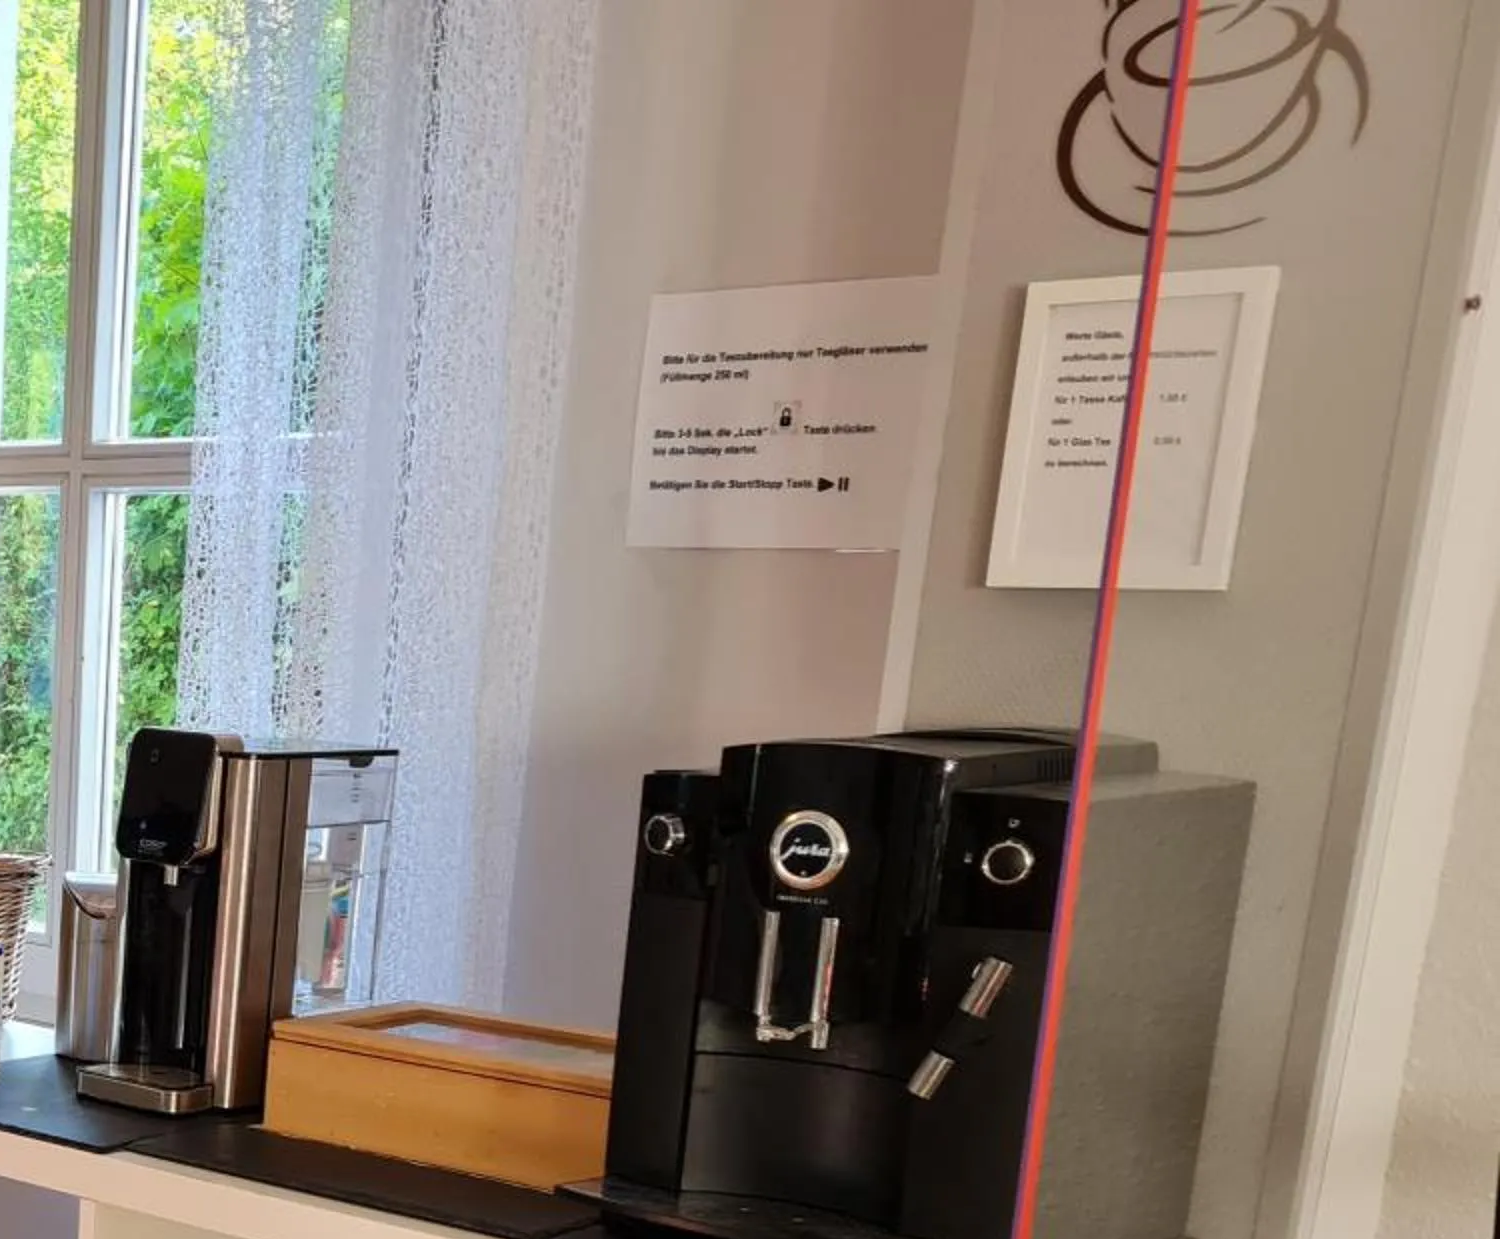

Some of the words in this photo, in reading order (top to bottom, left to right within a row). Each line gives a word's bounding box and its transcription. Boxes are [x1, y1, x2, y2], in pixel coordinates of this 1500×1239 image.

[662, 355, 685, 365] Bitte
[686, 353, 700, 364] für
[701, 353, 717, 363] die
[715, 427, 732, 438] die
[710, 478, 726, 490] die
